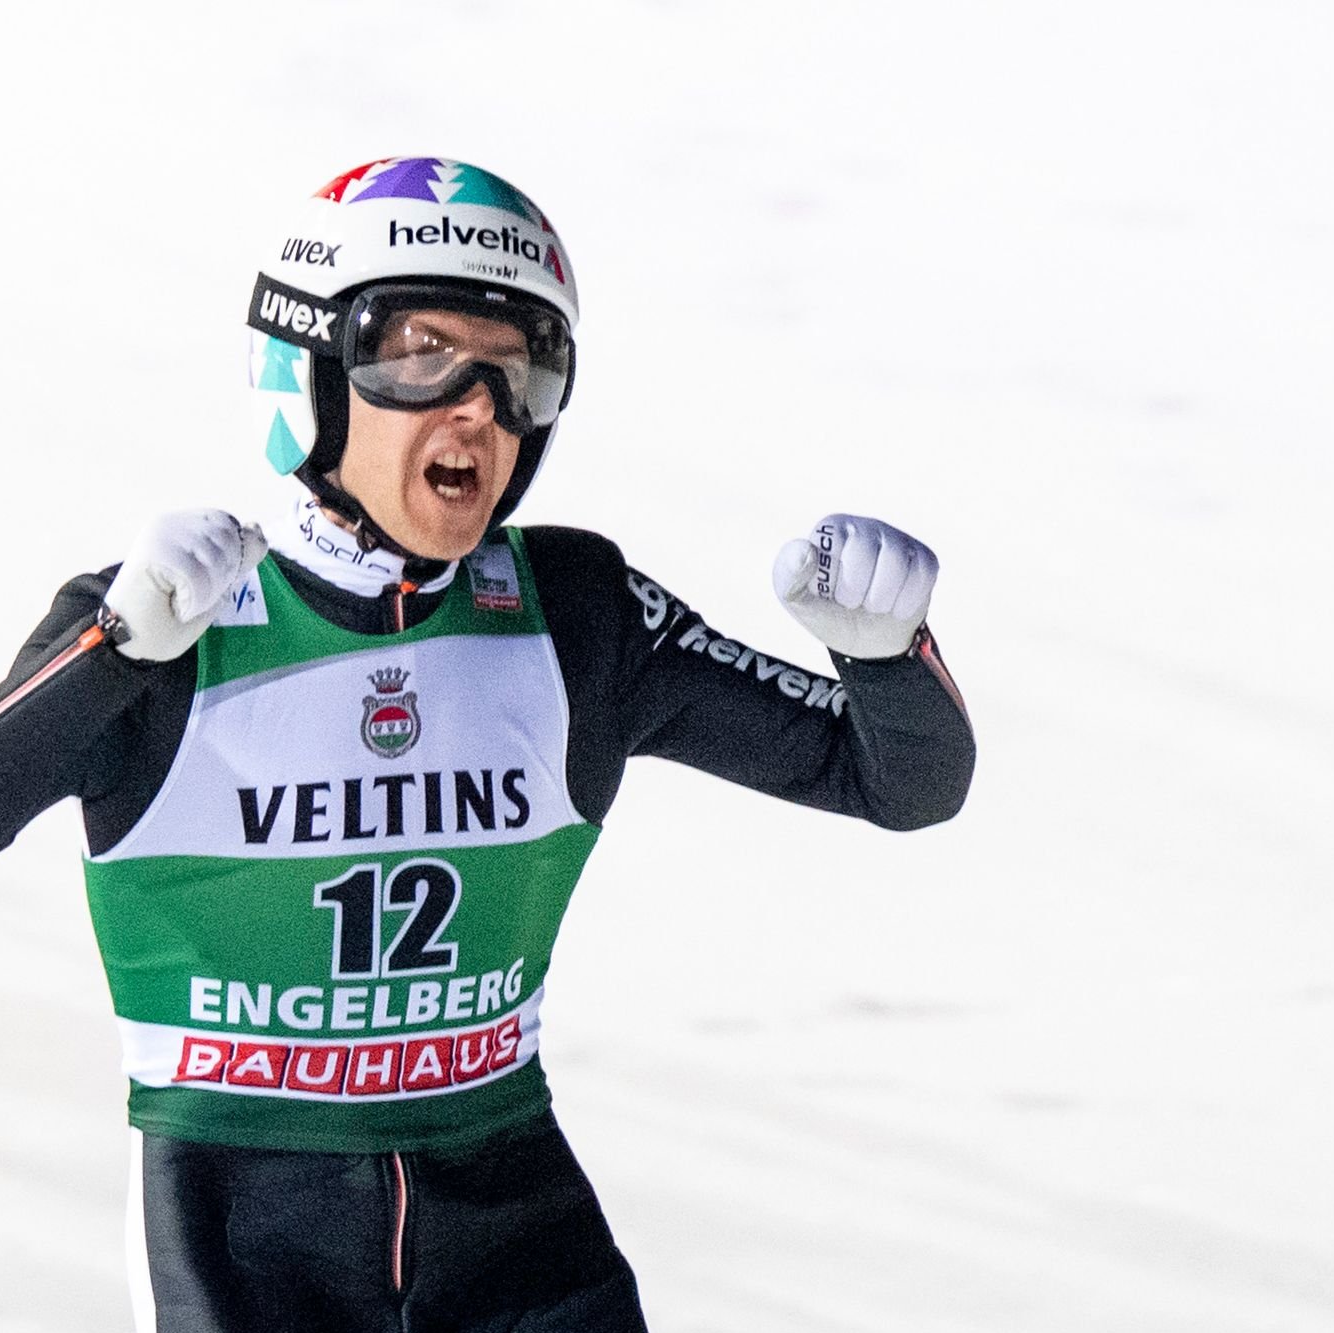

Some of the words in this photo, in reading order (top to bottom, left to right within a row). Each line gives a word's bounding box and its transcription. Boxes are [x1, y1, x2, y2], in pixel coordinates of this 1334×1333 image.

[280, 238, 342, 267] uvex
[389, 216, 540, 263] helvetia
[259, 289, 337, 342] uvex
[236, 768, 531, 845] VELTINS
[313, 857, 463, 981] 12
[189, 956, 524, 1031] ENGELBERG
[183, 1016, 520, 1088] BAUHAUS
